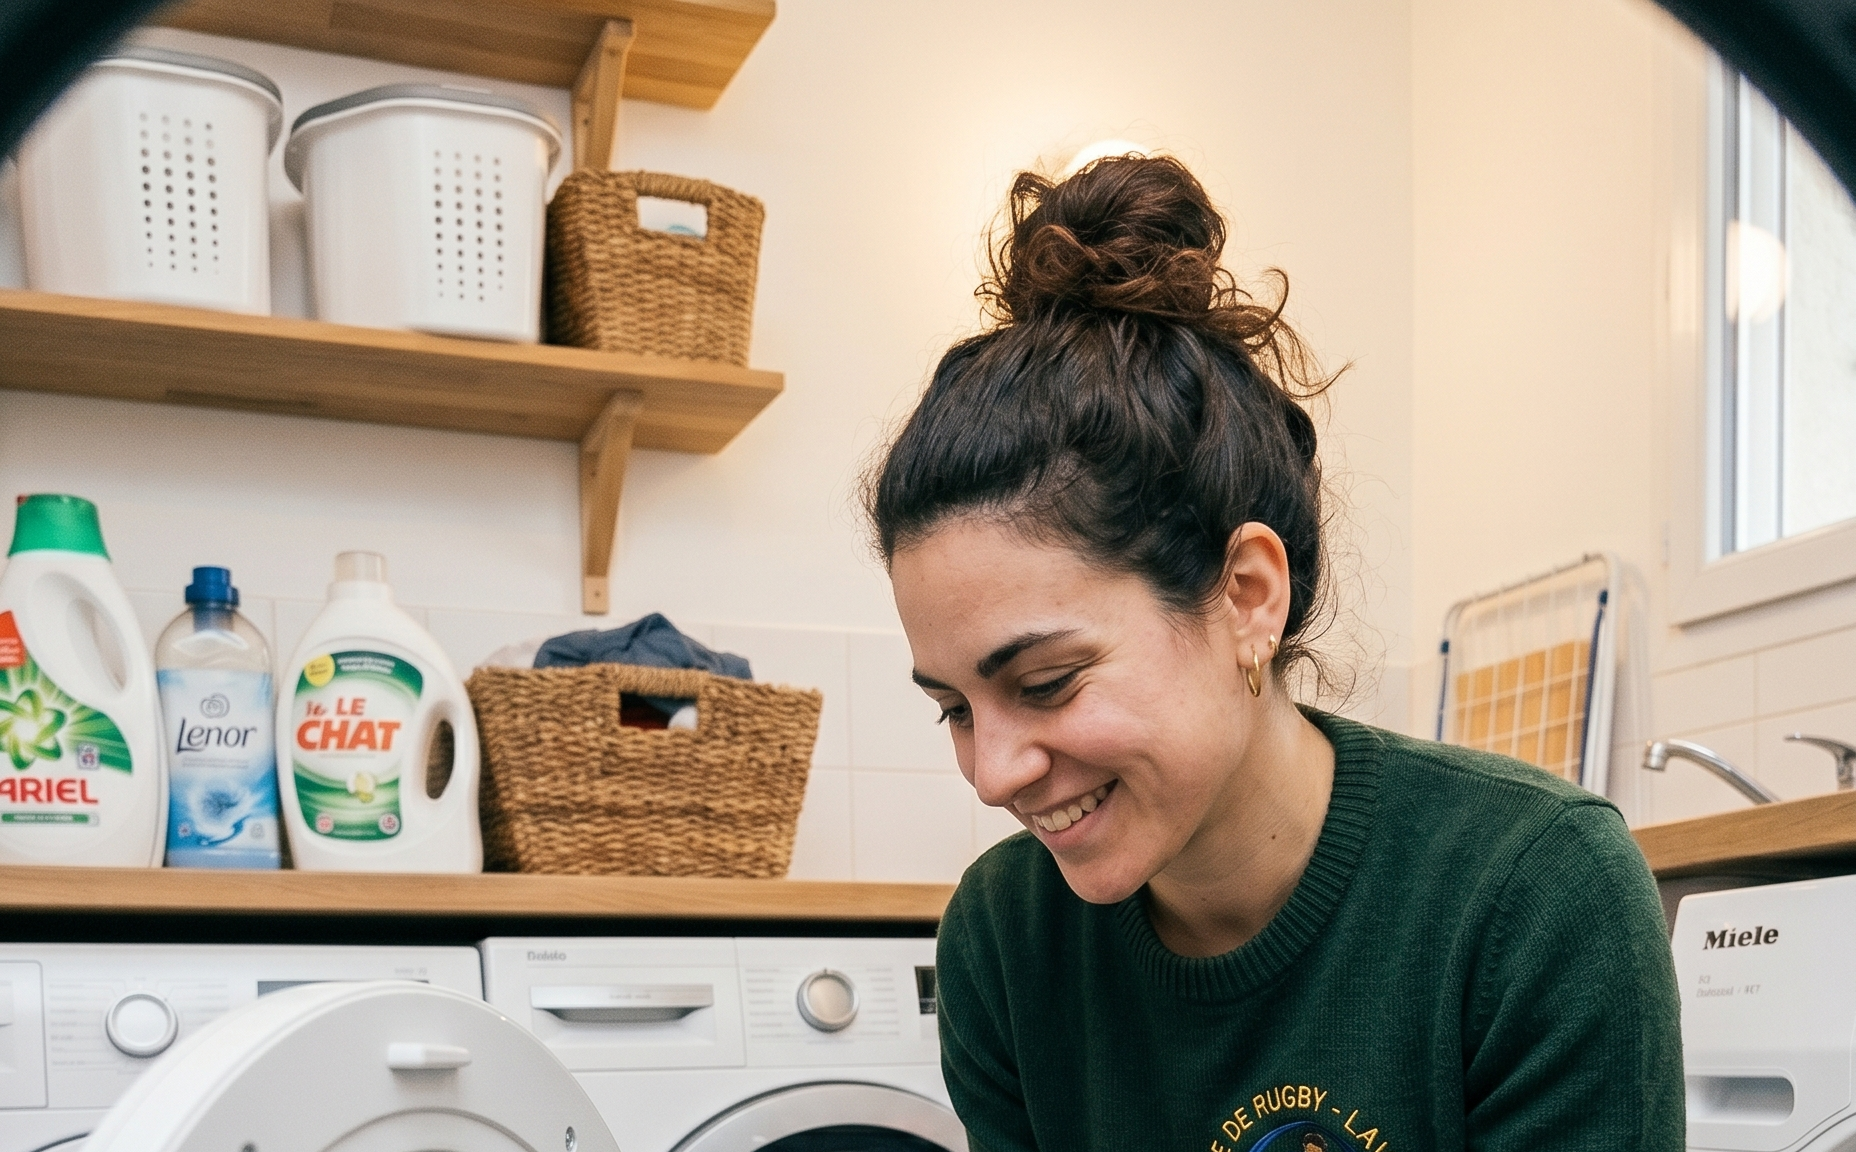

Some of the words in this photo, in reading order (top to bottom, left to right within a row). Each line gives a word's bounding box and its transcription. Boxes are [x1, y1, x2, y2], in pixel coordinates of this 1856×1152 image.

[335, 697, 367, 717] LE
[175, 717, 258, 755] Lenor
[296, 719, 403, 752] CHAT
[0, 777, 99, 805] ARIEL
[1702, 926, 1779, 951] Miele
[1221, 1106, 1254, 1142] DE
[1252, 1085, 1328, 1119] RUGBY
